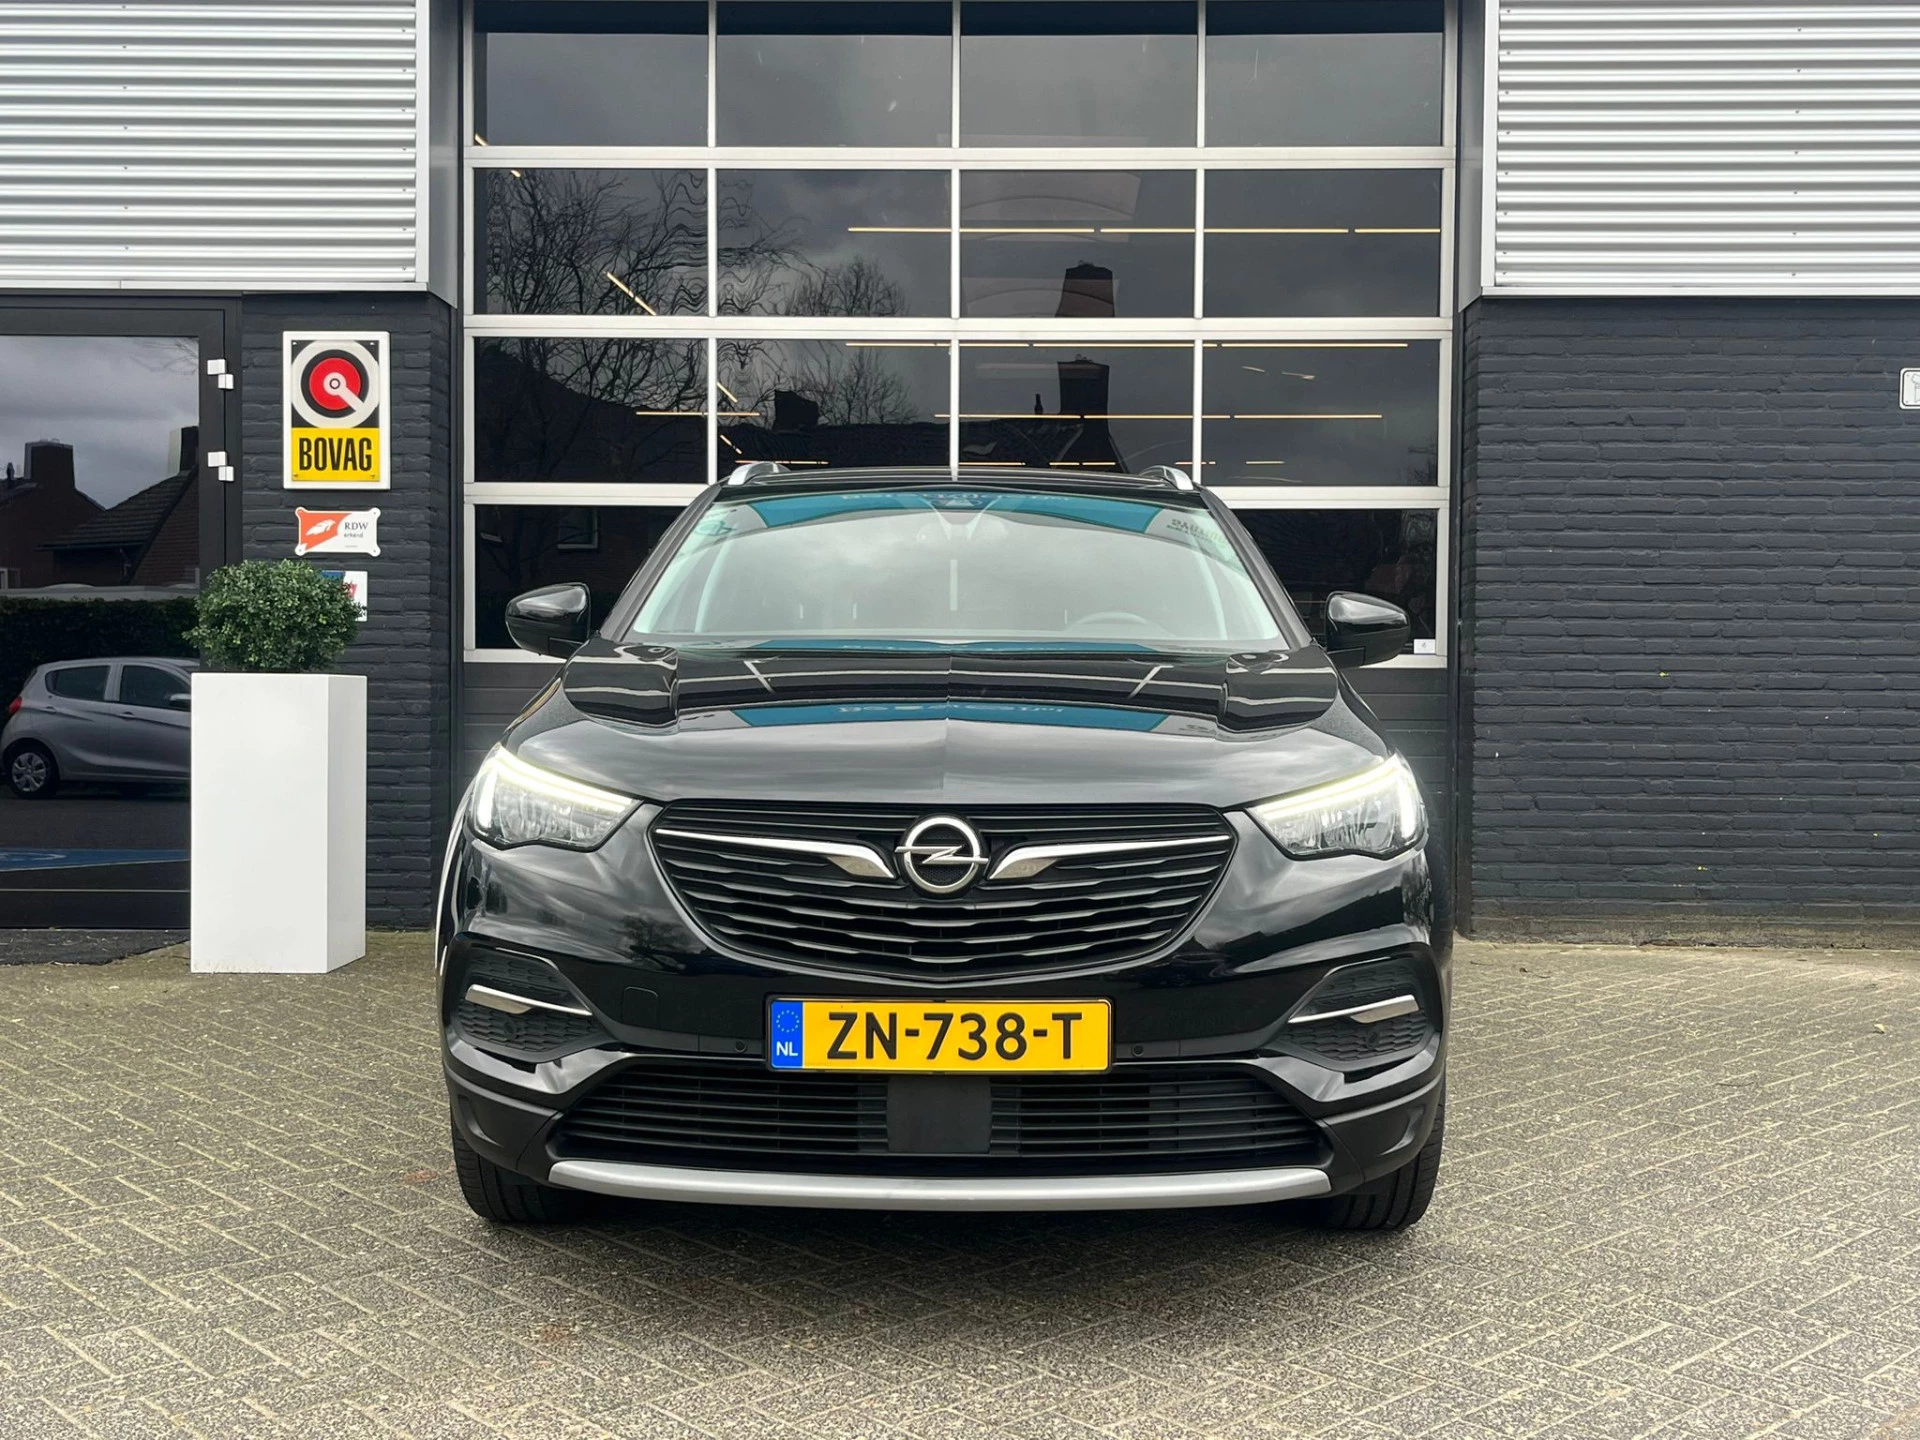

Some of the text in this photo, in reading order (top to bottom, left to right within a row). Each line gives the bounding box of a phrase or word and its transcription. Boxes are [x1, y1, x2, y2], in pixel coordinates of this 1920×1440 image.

[299, 437, 372, 471] BOVAG
[344, 521, 369, 530] RDW
[827, 1012, 1082, 1060] ZN-738-T
[776, 1041, 798, 1057] NL
